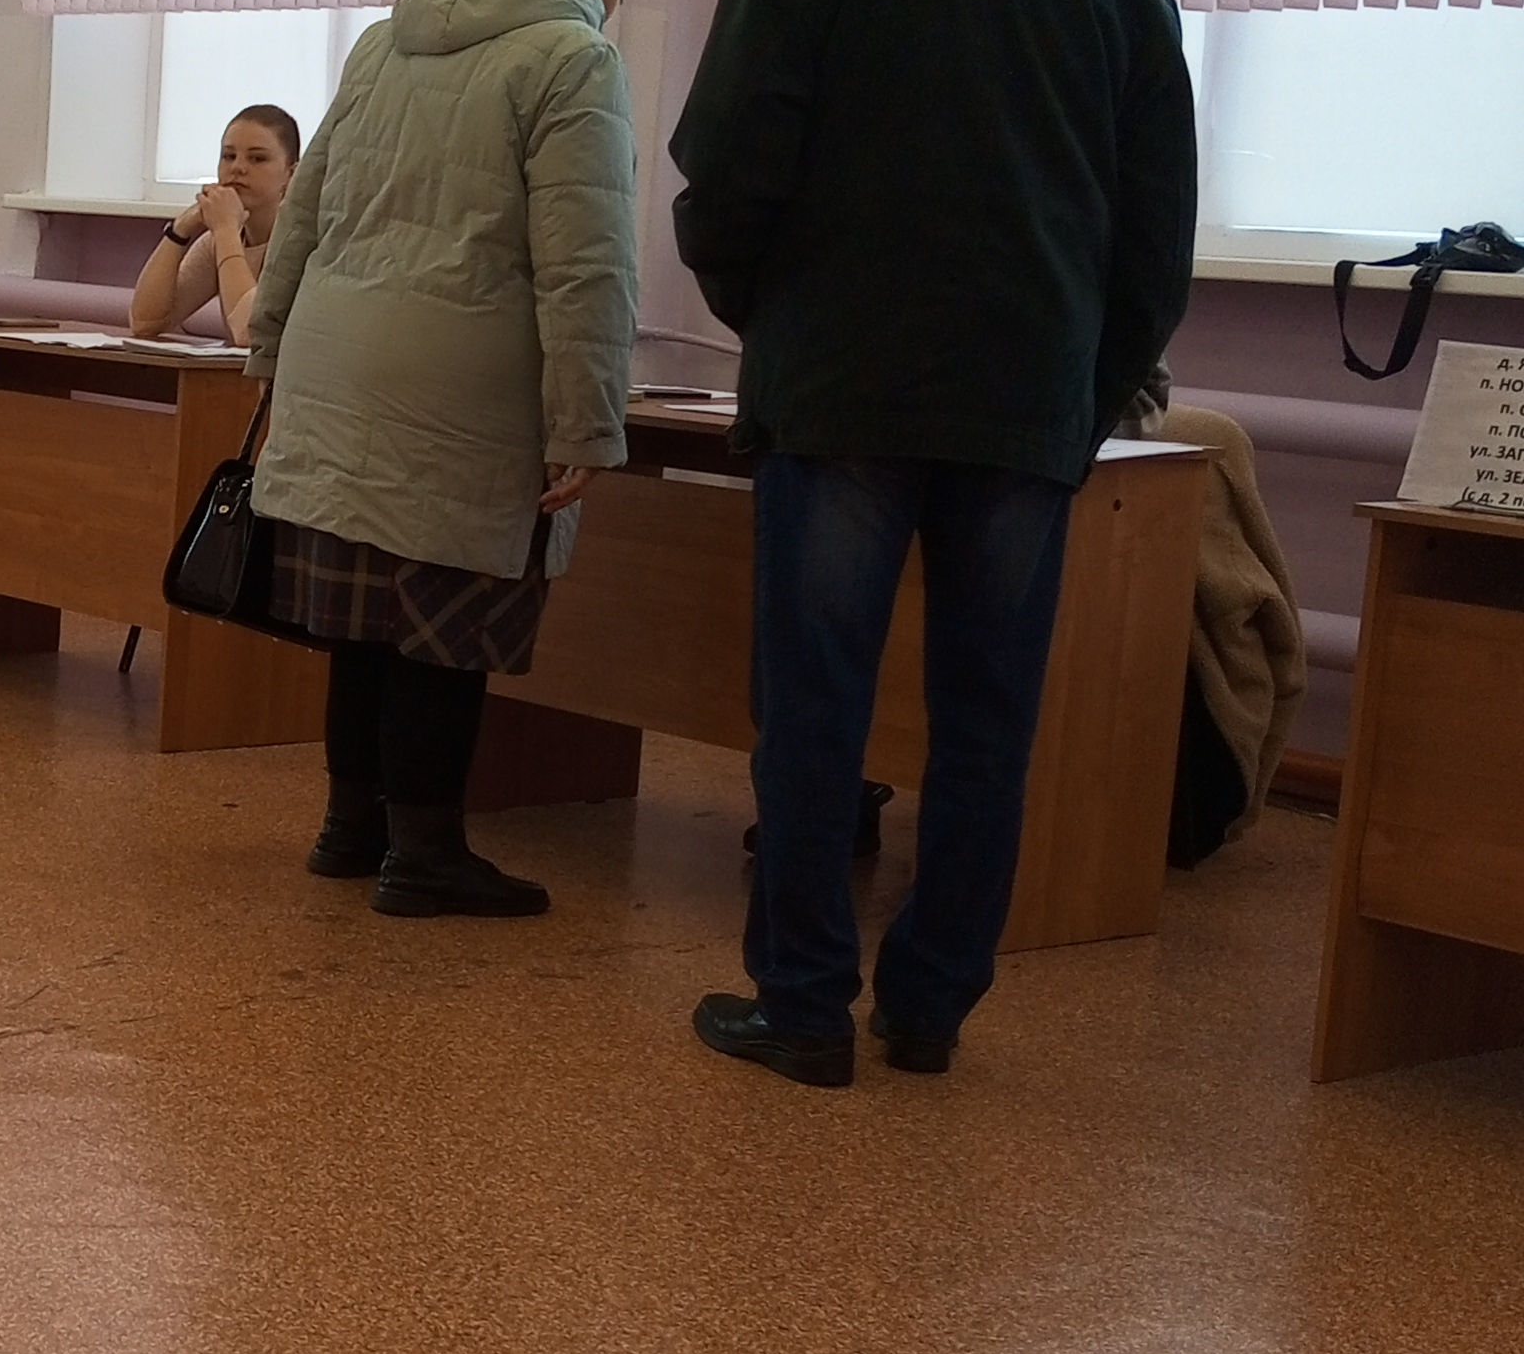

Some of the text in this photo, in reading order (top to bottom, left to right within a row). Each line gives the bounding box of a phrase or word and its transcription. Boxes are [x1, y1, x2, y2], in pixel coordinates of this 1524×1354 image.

[1496, 358, 1514, 372] д.
[1479, 378, 1494, 390] п.
[1499, 403, 1515, 415] п.
[1488, 425, 1503, 437] п.
[1469, 445, 1492, 459] ул.
[1476, 468, 1524, 485] ул. ЗЕ
[1476, 492, 1494, 506] д.
[1498, 492, 1510, 505] 2
